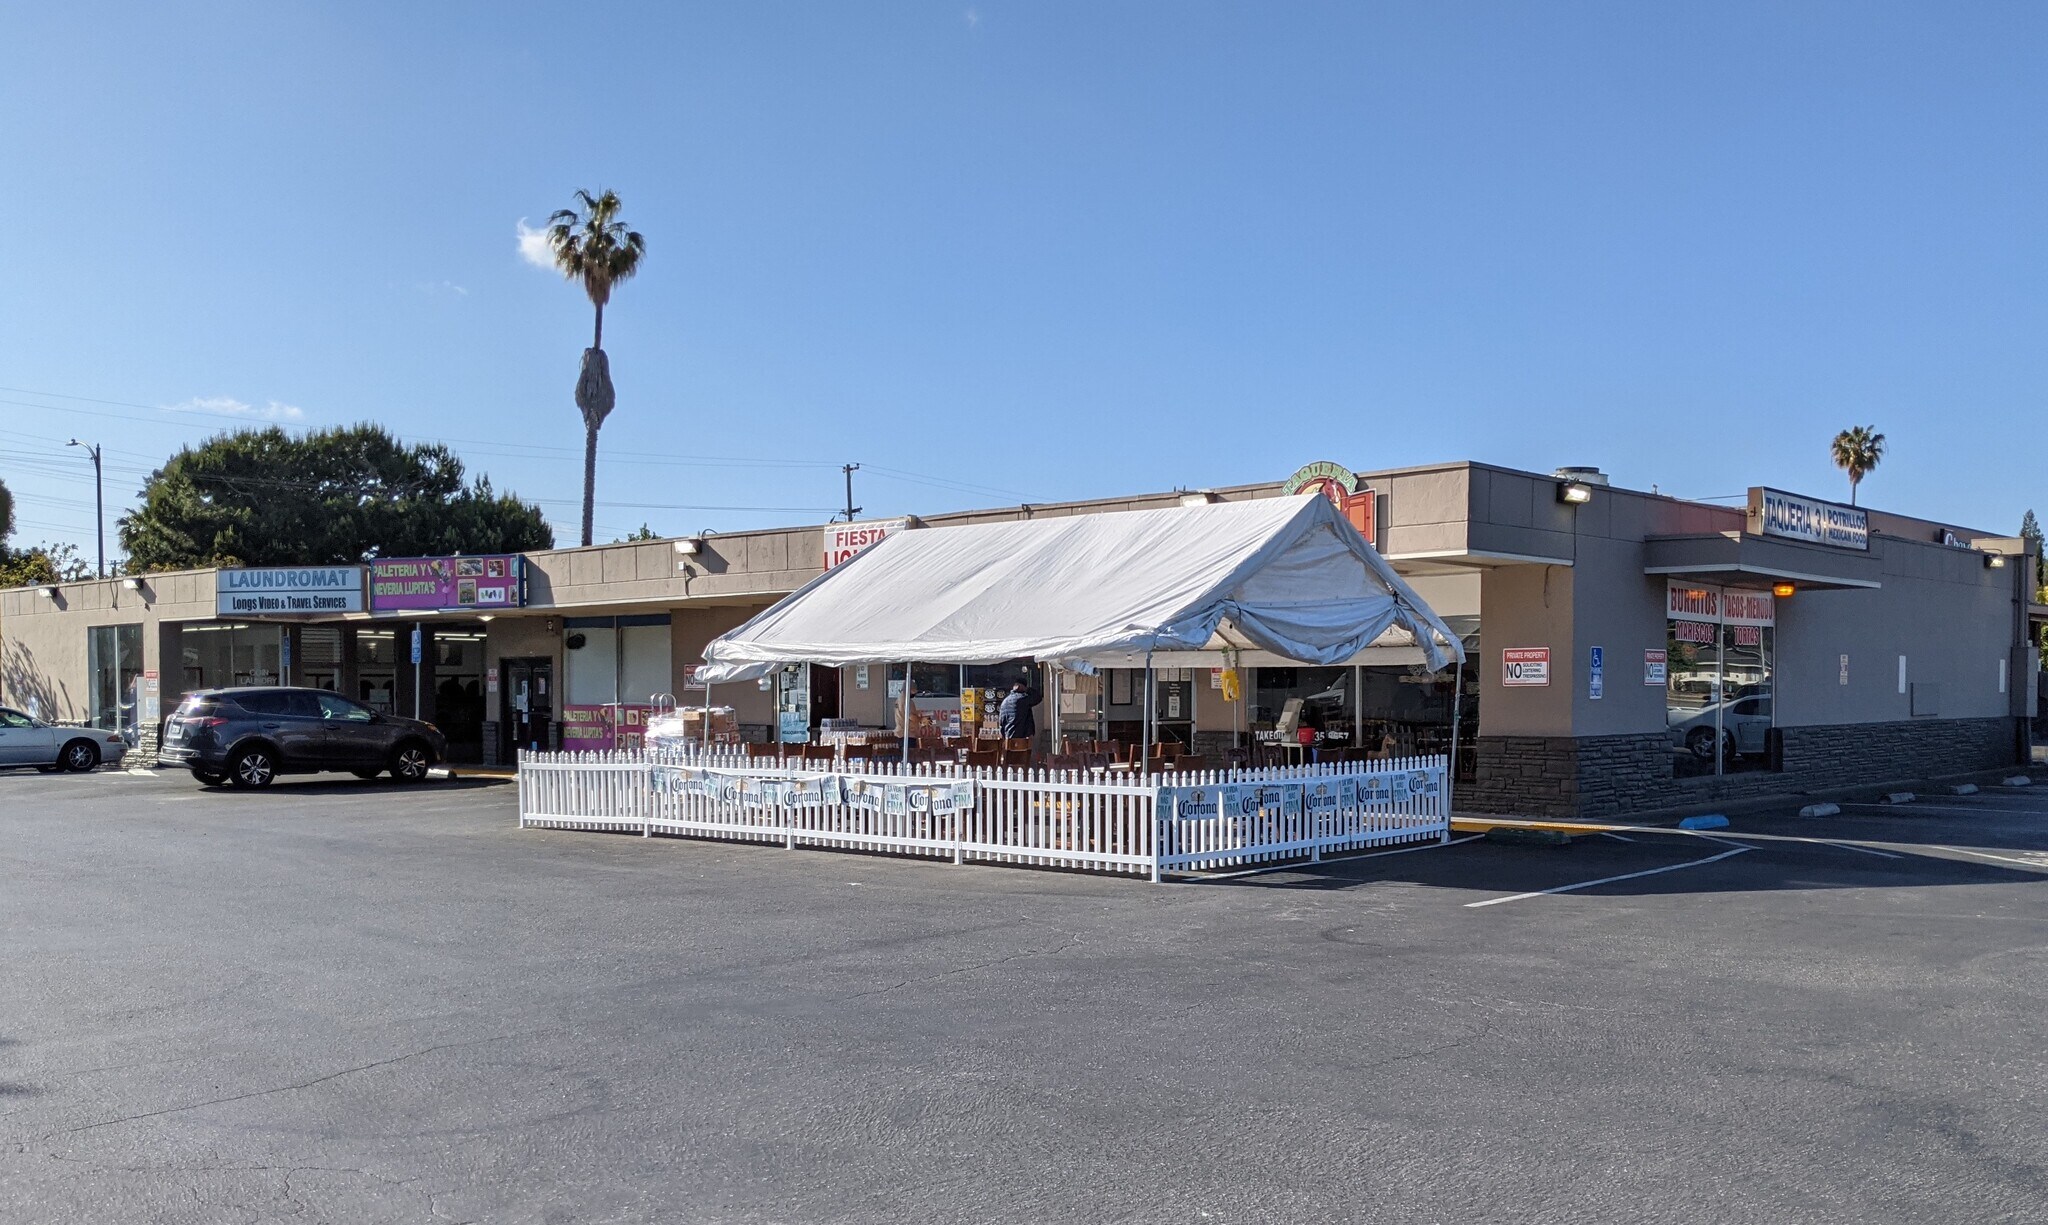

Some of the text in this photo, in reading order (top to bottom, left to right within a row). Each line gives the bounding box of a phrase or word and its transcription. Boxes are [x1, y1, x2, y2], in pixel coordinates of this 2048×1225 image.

[1281, 461, 1358, 496] TAQUERIA
[1766, 497, 1822, 537] TAQUERIA 3
[1827, 509, 1865, 531] POTRILLOS
[836, 529, 886, 547] FIESTA
[1828, 528, 1866, 544] MEXICAN FOOD
[229, 570, 349, 588] LAUNDROMAT
[373, 564, 427, 578] PALETERIA Y
[373, 581, 435, 596] NEVERIA LUPITA'S
[232, 597, 258, 611] Longs
[280, 600, 286, 609] &
[287, 596, 312, 609] TRAVEL
[313, 595, 347, 609] SERVICES
[1670, 587, 1717, 616] BURRITOS
[1676, 621, 1715, 643] MARISCOS
[1734, 627, 1760, 645] TORTAS
[1524, 651, 1546, 659] PROPERTY
[1506, 663, 1522, 678] NO
[671, 777, 703, 792] Corona
[1408, 777, 1438, 793] Corona
[723, 786, 759, 804] Corona
[783, 790, 820, 807] Corona
[841, 788, 880, 807] Corona
[909, 792, 953, 811] Corona
[953, 794, 971, 805] FINA
[1242, 791, 1280, 814] Corona
[1306, 792, 1337, 810] Corona
[1359, 787, 1389, 803] Corona
[1178, 800, 1217, 818] Corona
